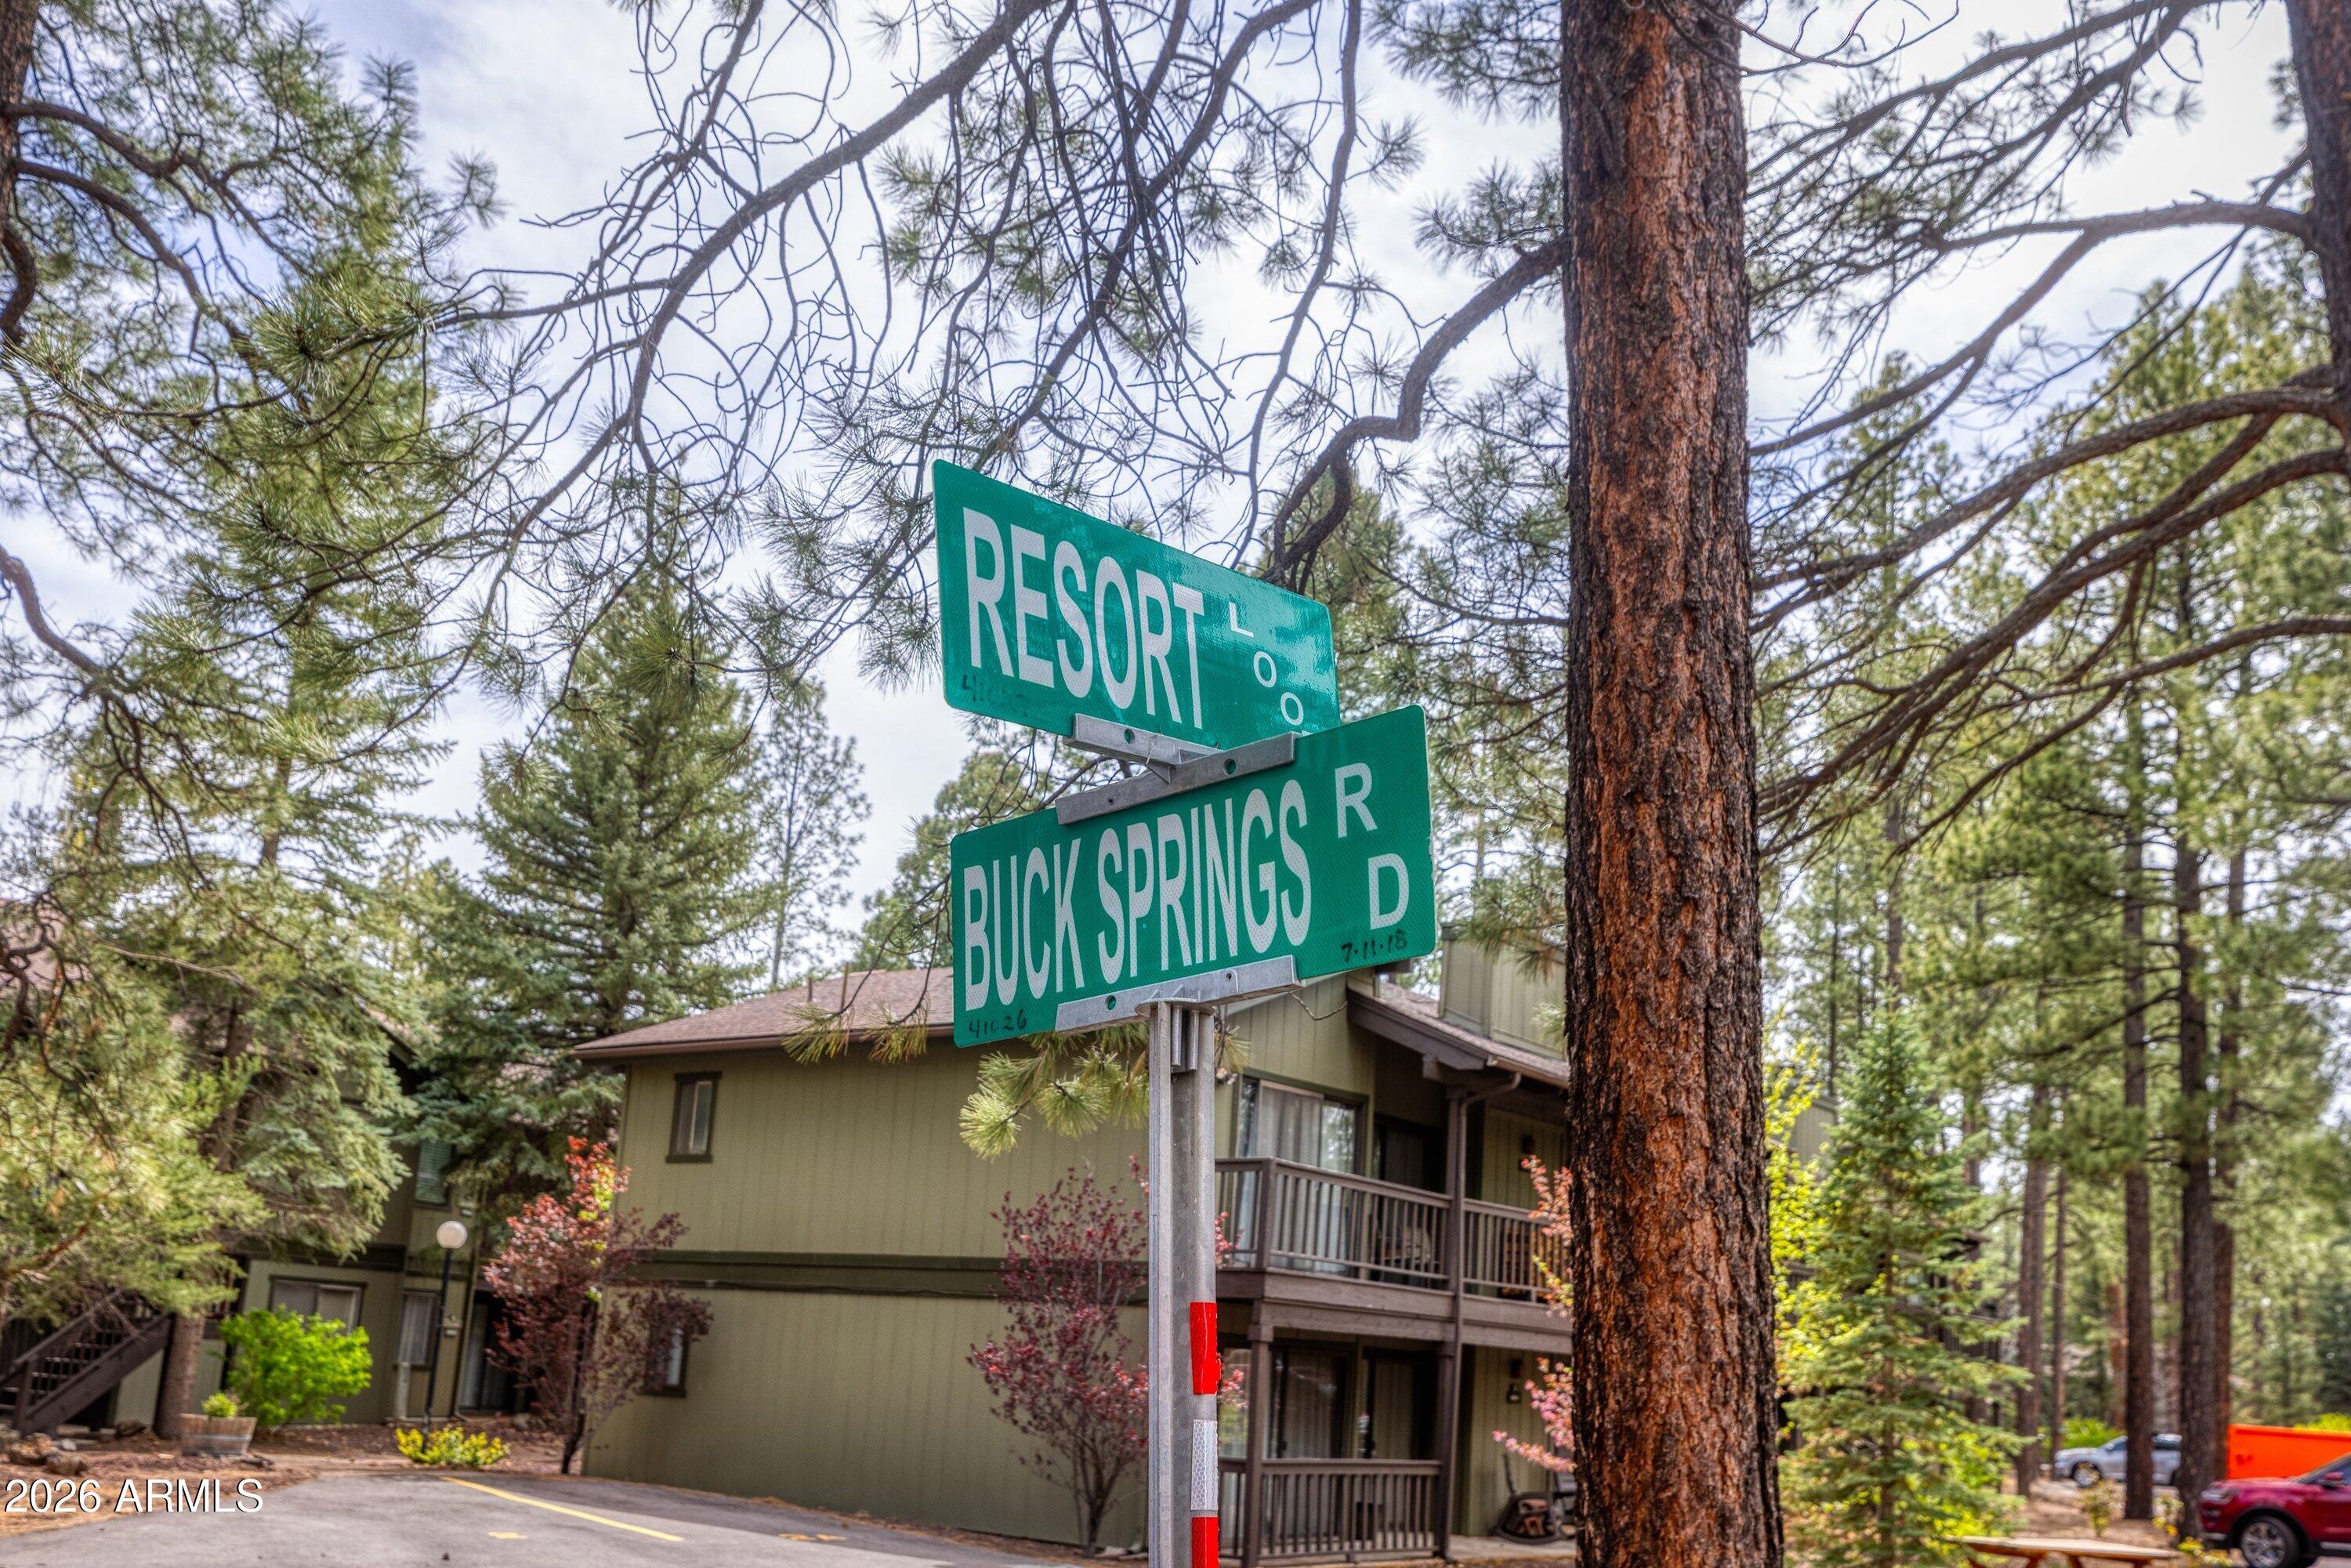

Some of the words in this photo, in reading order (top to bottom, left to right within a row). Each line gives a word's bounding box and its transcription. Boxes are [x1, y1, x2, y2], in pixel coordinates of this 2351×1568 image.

[962, 506, 1204, 730] RESORT
[1228, 601, 1313, 737] LOO
[964, 838, 1085, 1012] BUCK
[1098, 780, 1311, 984] SPRINGS
